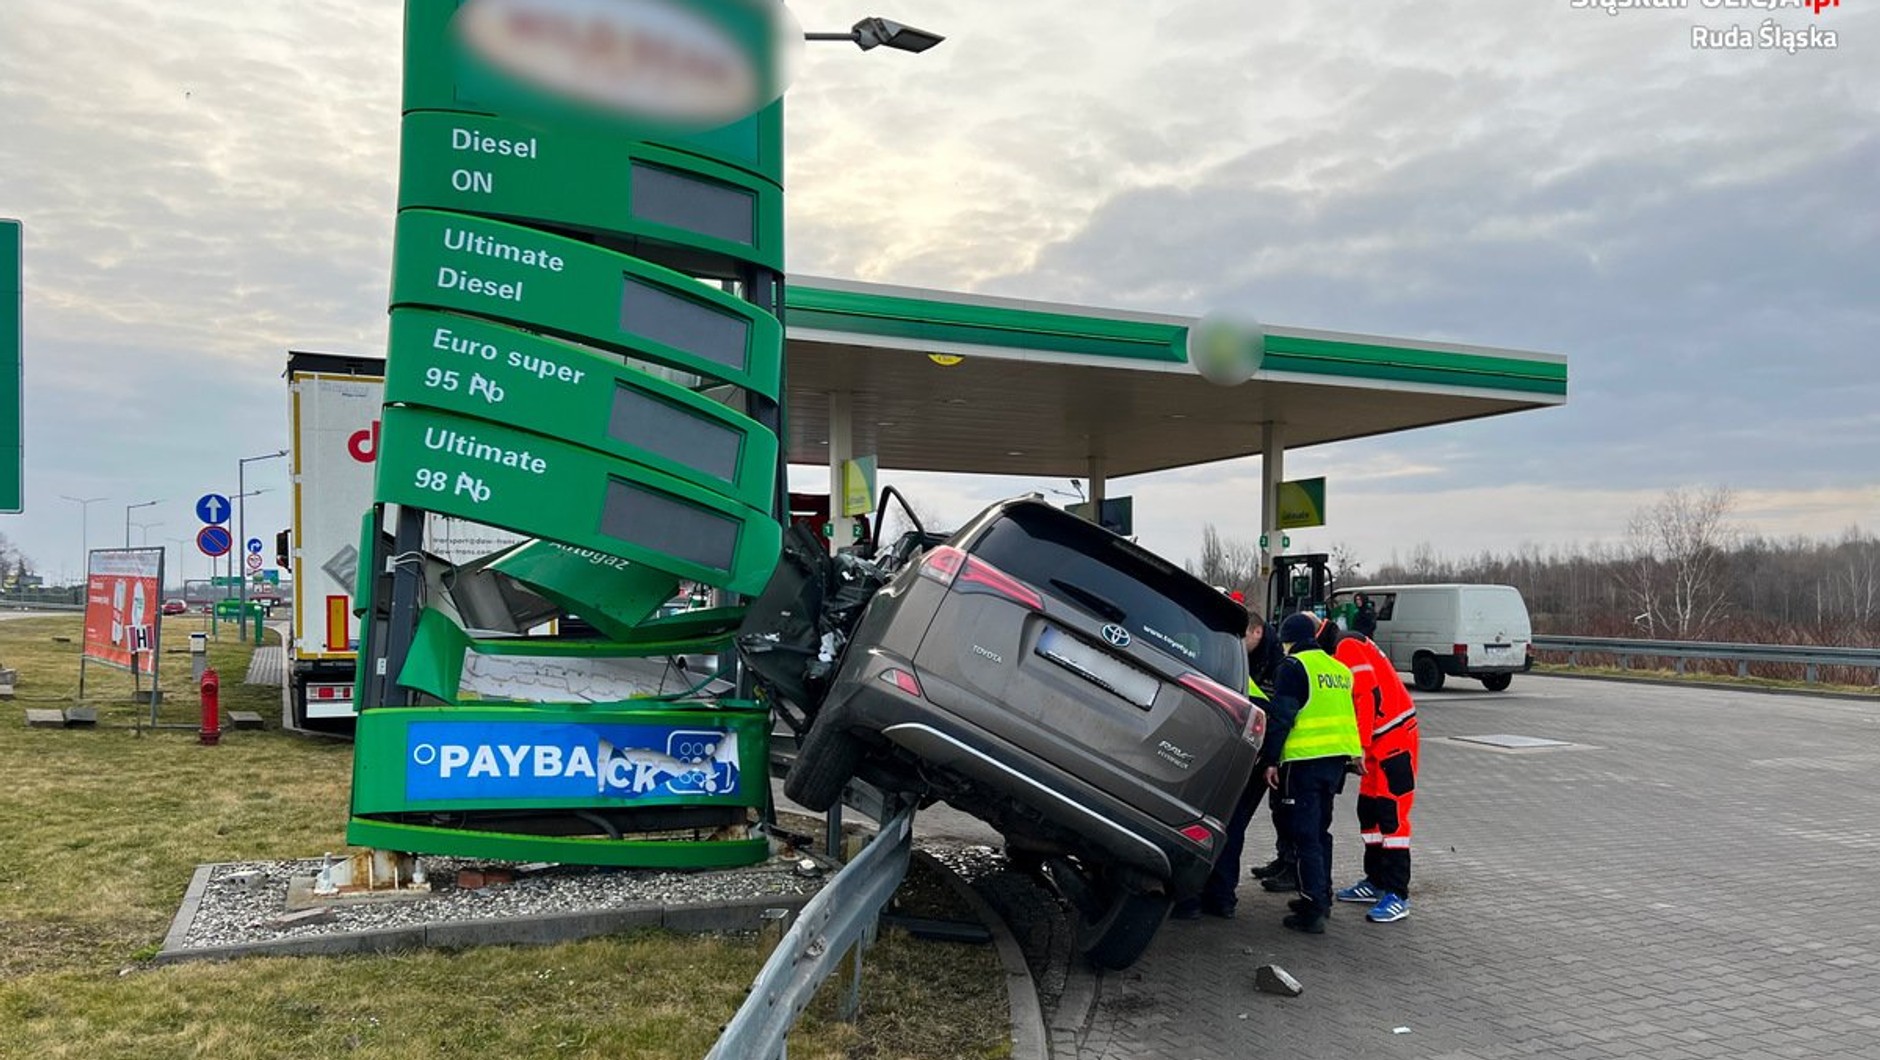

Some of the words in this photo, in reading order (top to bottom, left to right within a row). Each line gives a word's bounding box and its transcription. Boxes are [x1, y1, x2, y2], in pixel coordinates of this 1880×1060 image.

[452, 128, 537, 158] Diesel
[451, 169, 492, 193] ON
[443, 228, 565, 272] Ultimate
[437, 267, 523, 302] Diesel
[433, 328, 498, 361] Euro
[508, 350, 585, 385] super
[424, 367, 460, 391] 95
[423, 427, 547, 475] Ultimate
[414, 468, 447, 491] 98
[136, 627, 147, 648] H
[973, 644, 1002, 664] TOYOTA
[1317, 673, 1351, 689] POLICJ
